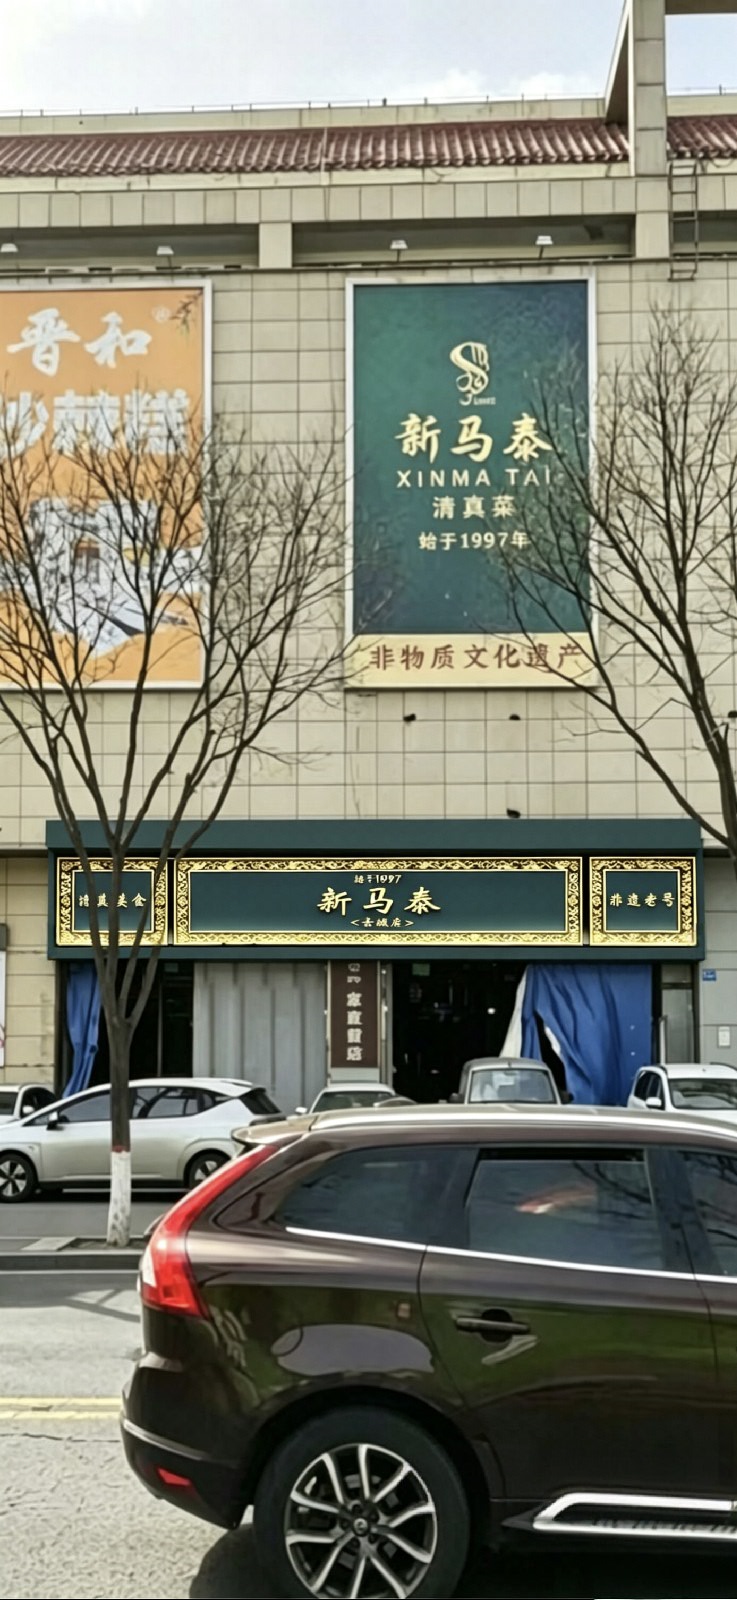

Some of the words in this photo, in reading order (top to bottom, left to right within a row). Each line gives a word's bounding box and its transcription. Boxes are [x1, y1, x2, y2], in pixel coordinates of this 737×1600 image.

[7, 307, 152, 376] 晋和
[395, 413, 553, 464] 新马泰
[396, 469, 491, 488] XINMA
[505, 466, 551, 487] TAI
[433, 495, 516, 520] 清真菜
[418, 531, 532, 551] 始于1997年
[369, 643, 584, 673] 非物质文化遗产
[316, 886, 442, 916] 新马泰
[609, 892, 676, 907] 非遗老号
